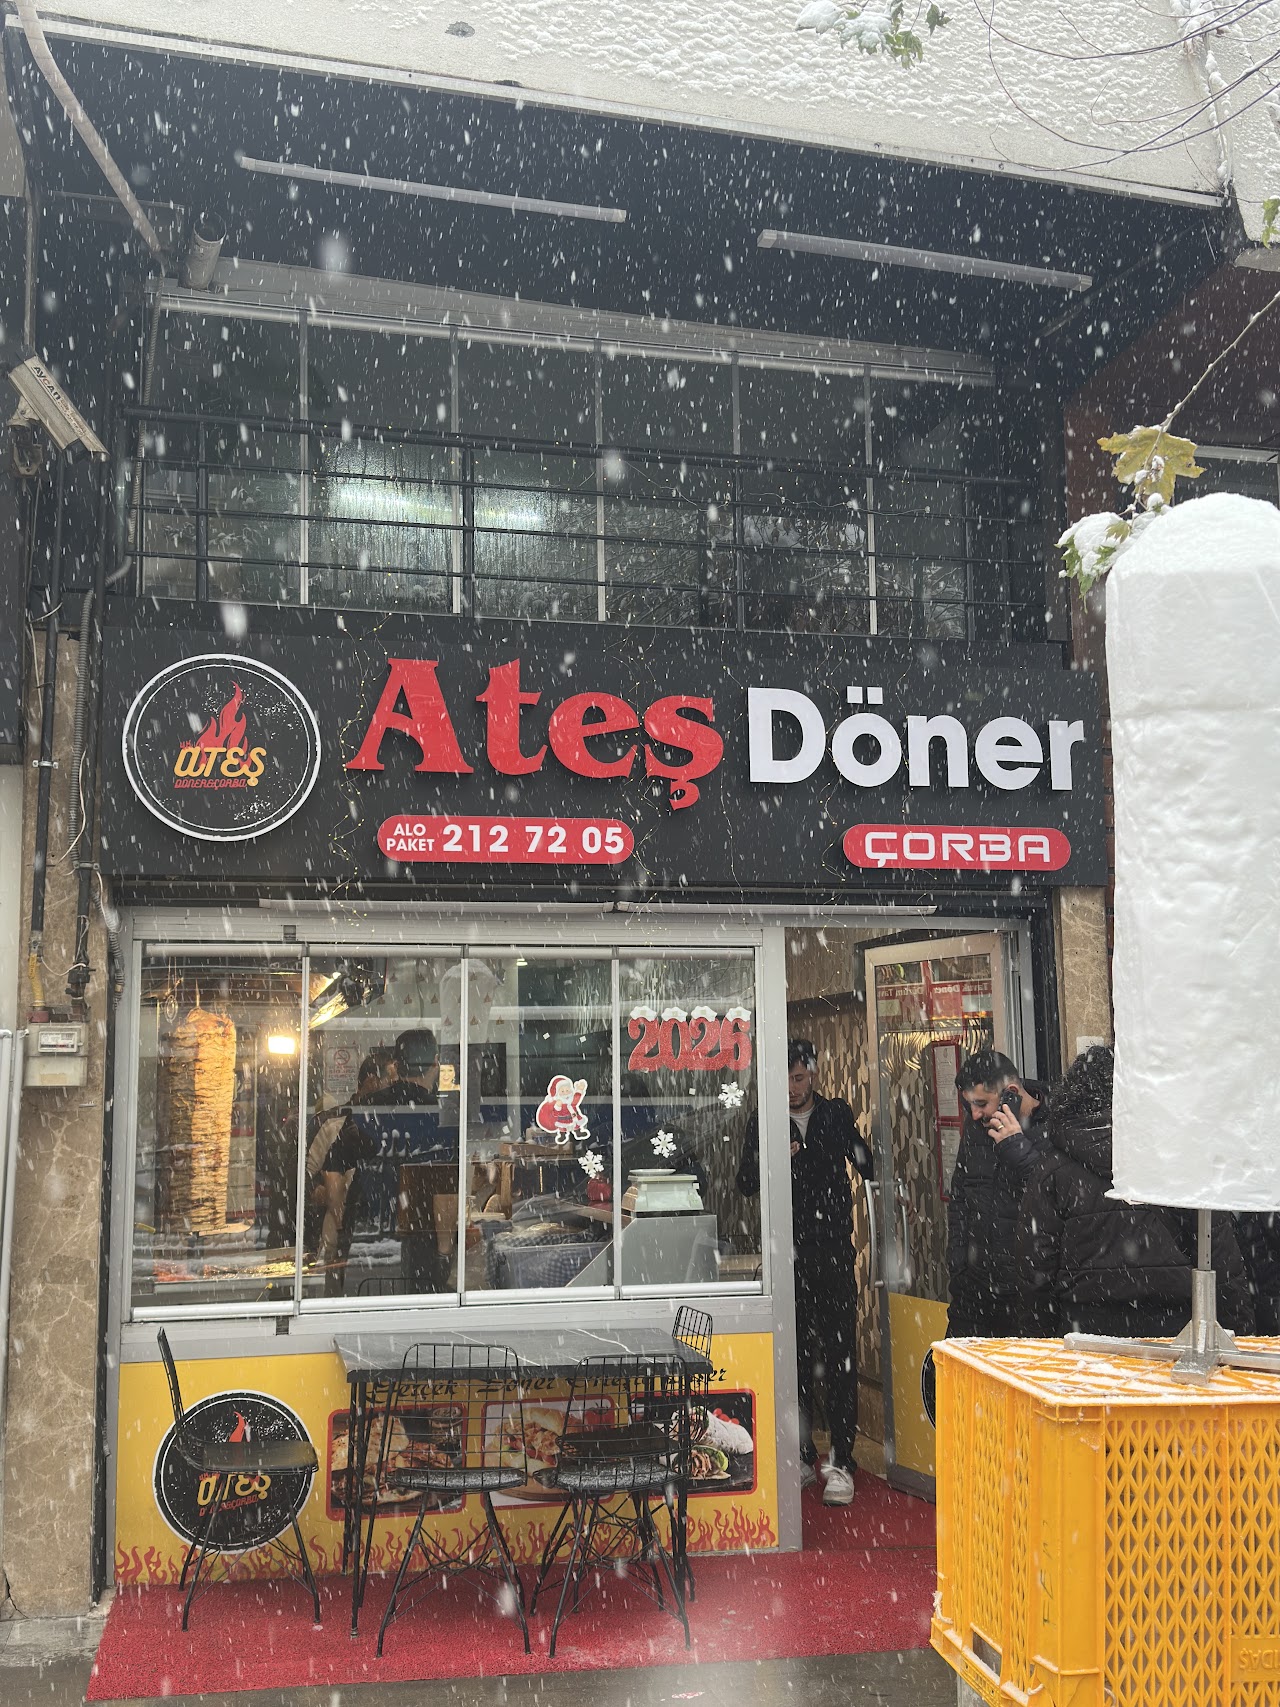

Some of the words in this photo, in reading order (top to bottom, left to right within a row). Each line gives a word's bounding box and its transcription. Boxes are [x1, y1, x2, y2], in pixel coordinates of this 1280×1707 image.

[346, 657, 724, 811] Ateş
[747, 686, 1086, 792] Döner
[386, 838, 435, 852] PAKET
[393, 823, 427, 837] ALO
[442, 824, 509, 853] 212
[525, 825, 567, 853] 72
[582, 826, 624, 854] 05
[864, 832, 1051, 868] ÇORBA
[628, 1006, 753, 1072] 2026
